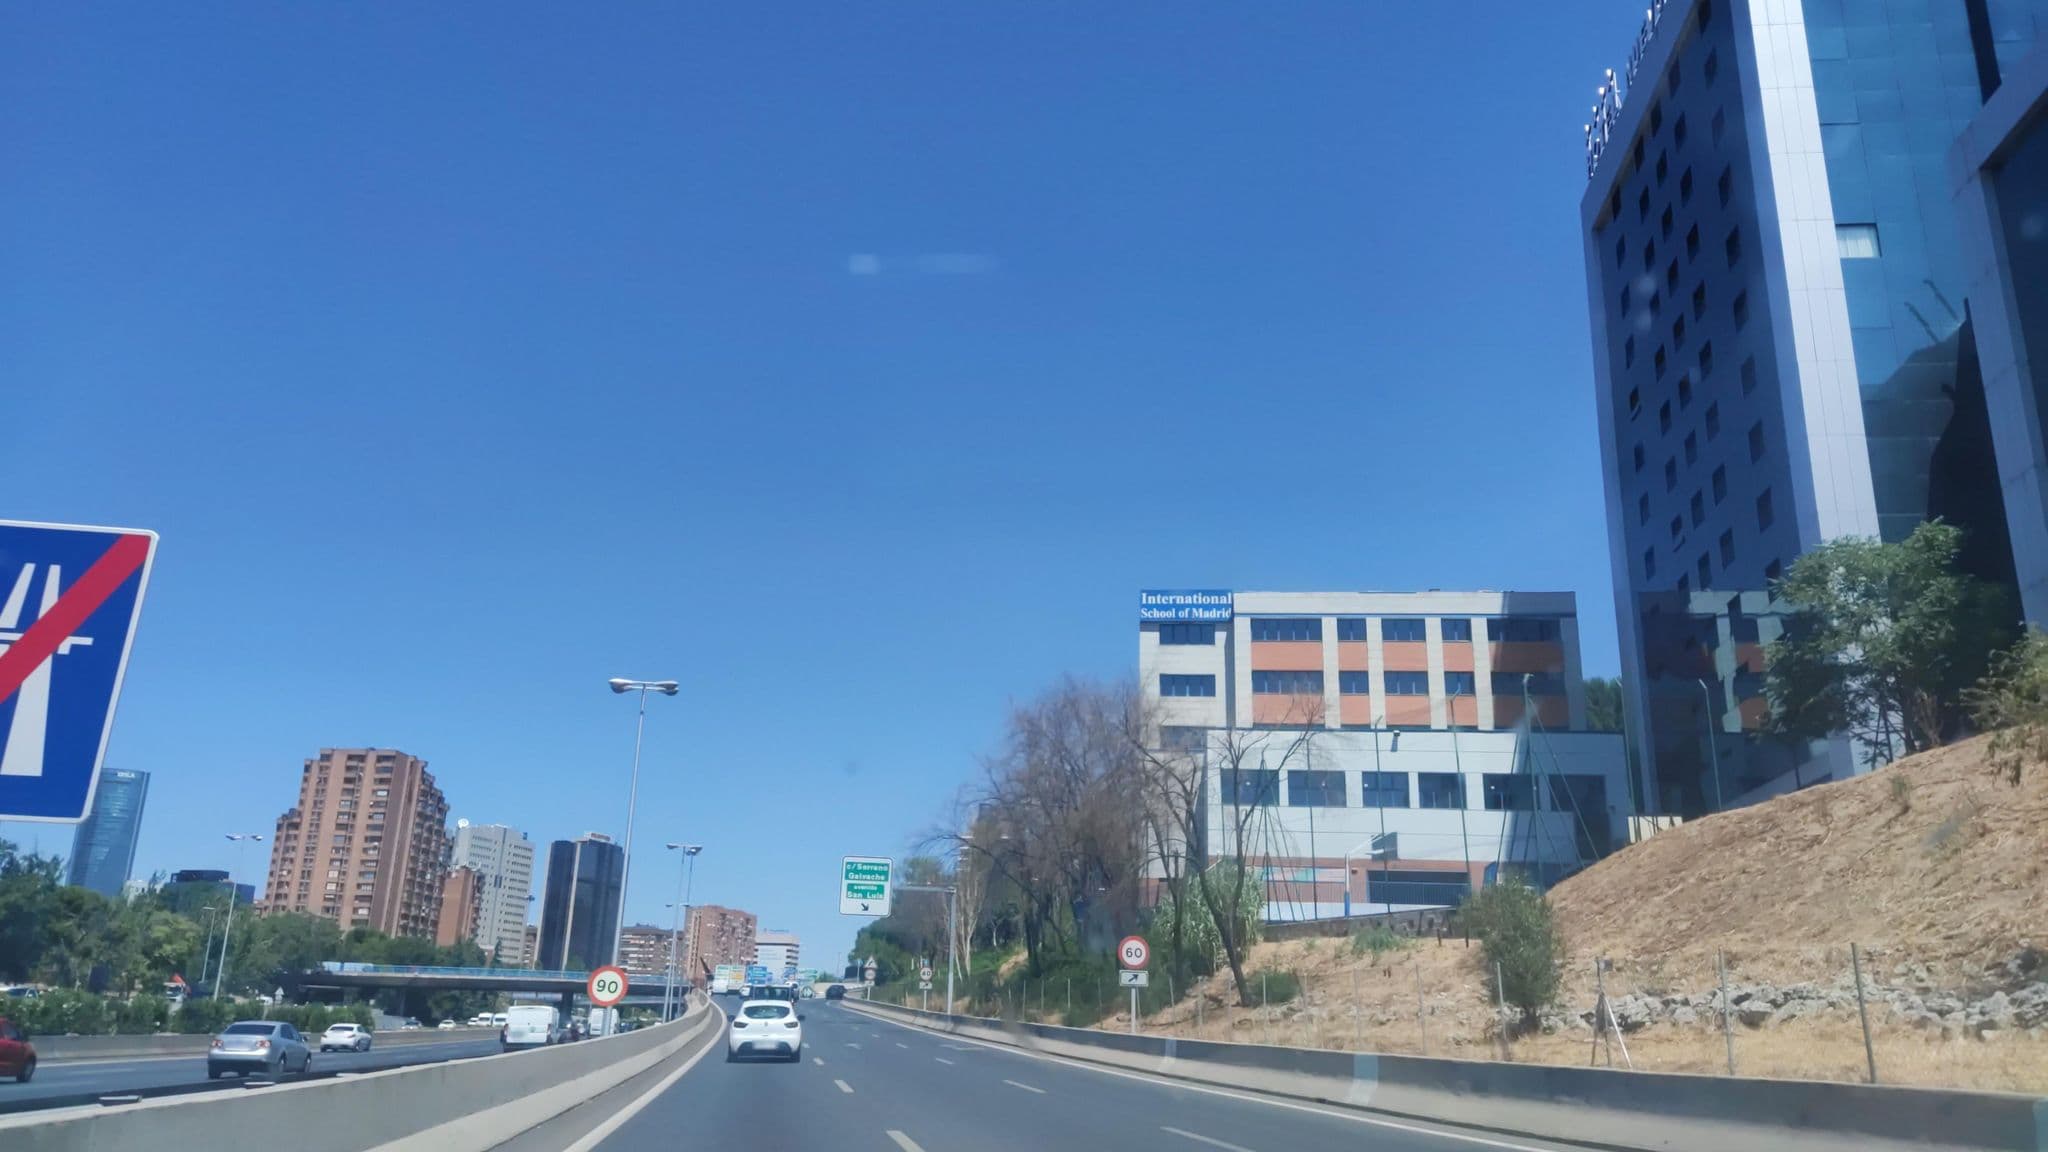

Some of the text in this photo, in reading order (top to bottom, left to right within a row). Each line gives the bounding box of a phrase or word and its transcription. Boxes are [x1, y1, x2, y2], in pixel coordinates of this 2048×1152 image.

[1141, 592, 1233, 605] International
[1140, 608, 1232, 619] School of Madrid
[848, 873, 886, 881] Galvache
[1125, 947, 1143, 959] 60
[596, 979, 619, 994] 90
